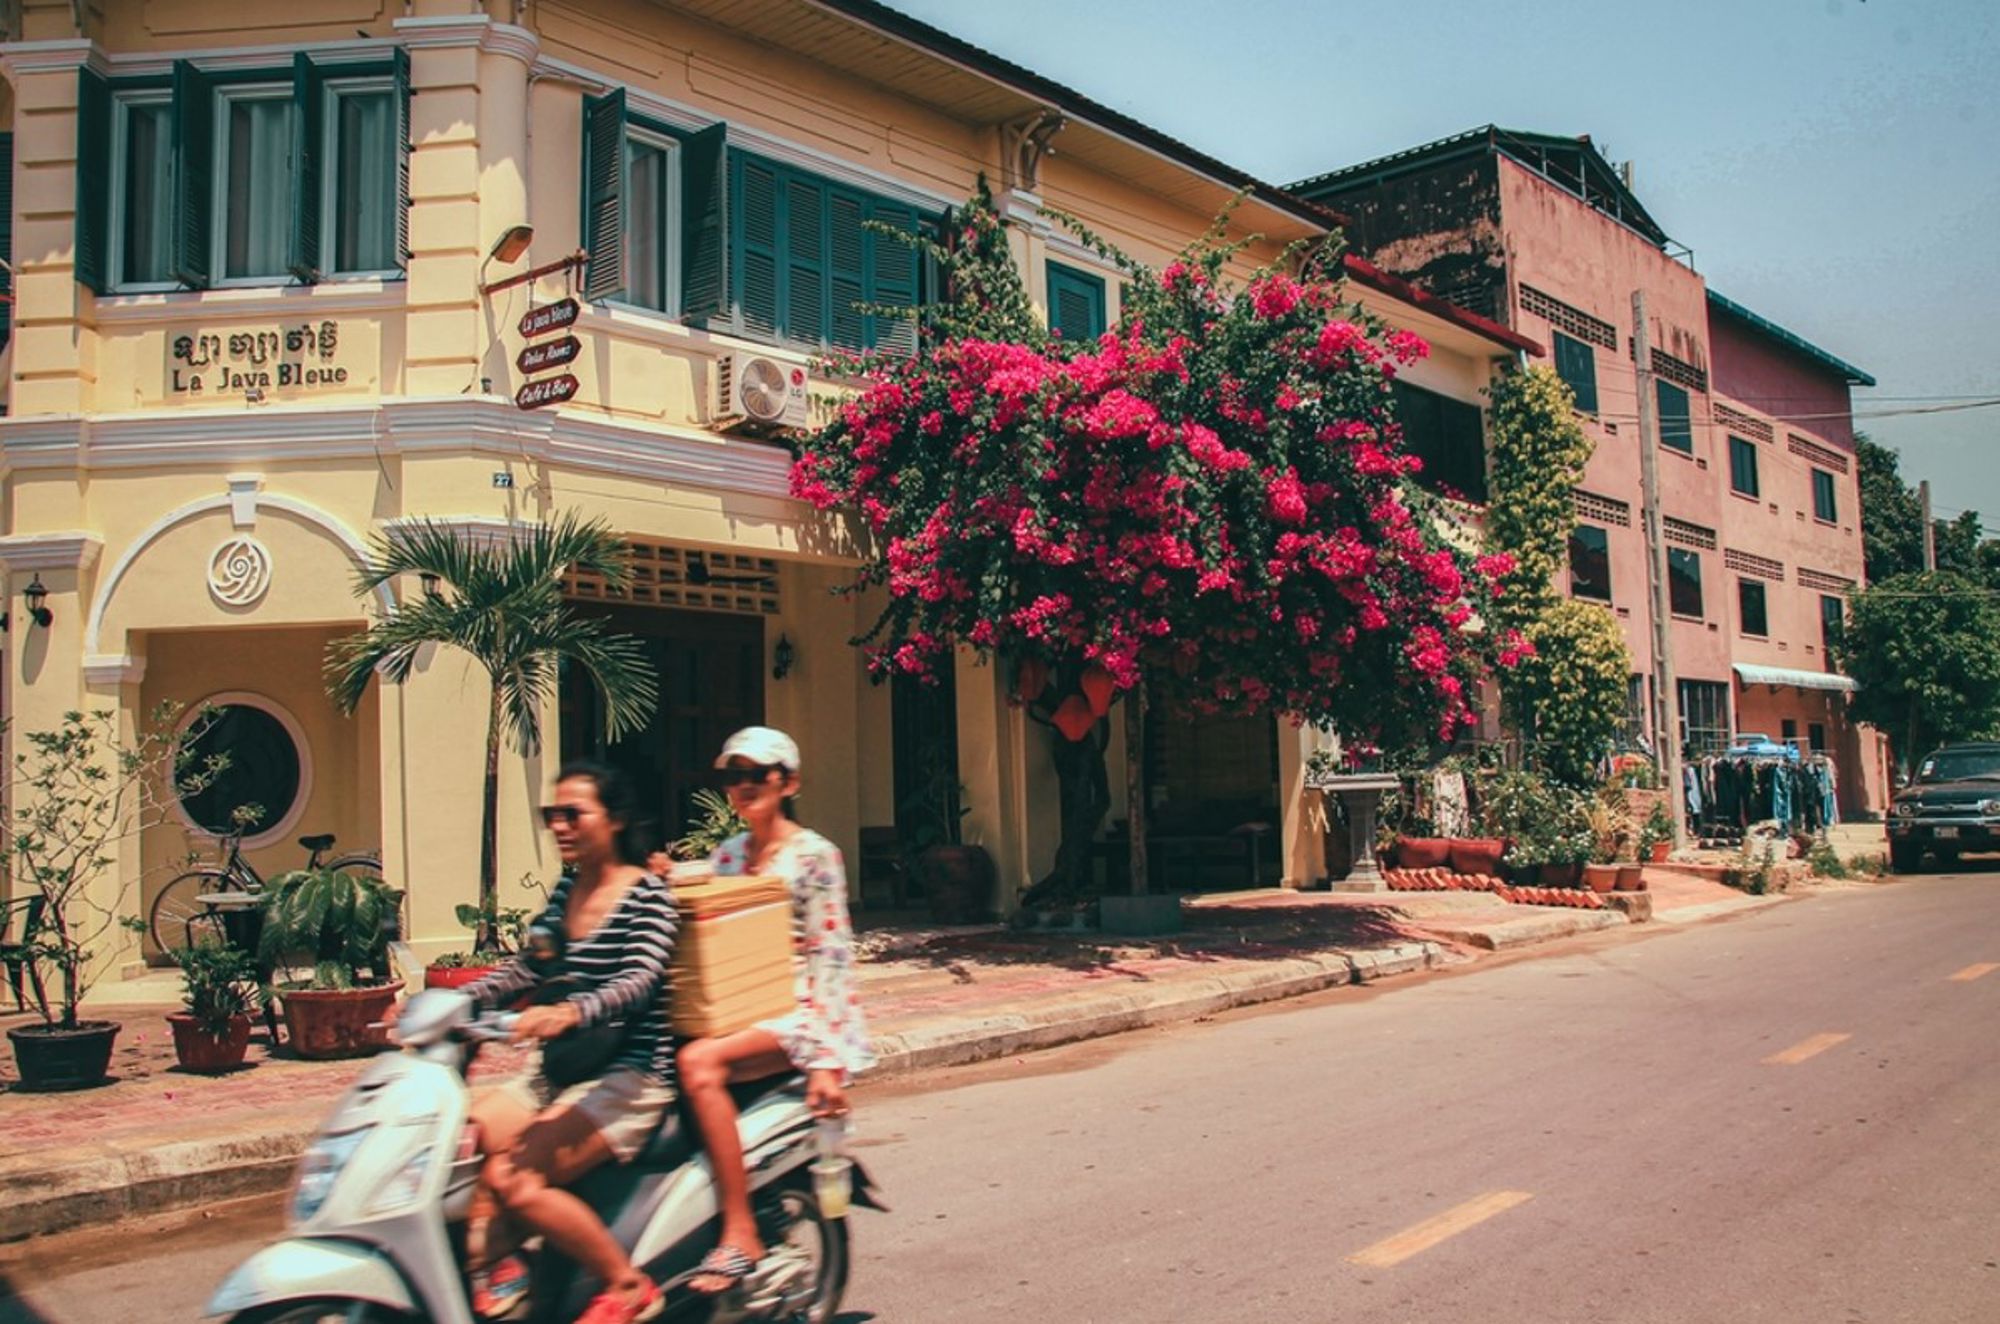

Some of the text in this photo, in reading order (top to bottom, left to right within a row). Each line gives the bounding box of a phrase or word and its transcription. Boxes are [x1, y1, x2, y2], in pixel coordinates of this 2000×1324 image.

[173, 363, 348, 392] La Java Bleue
